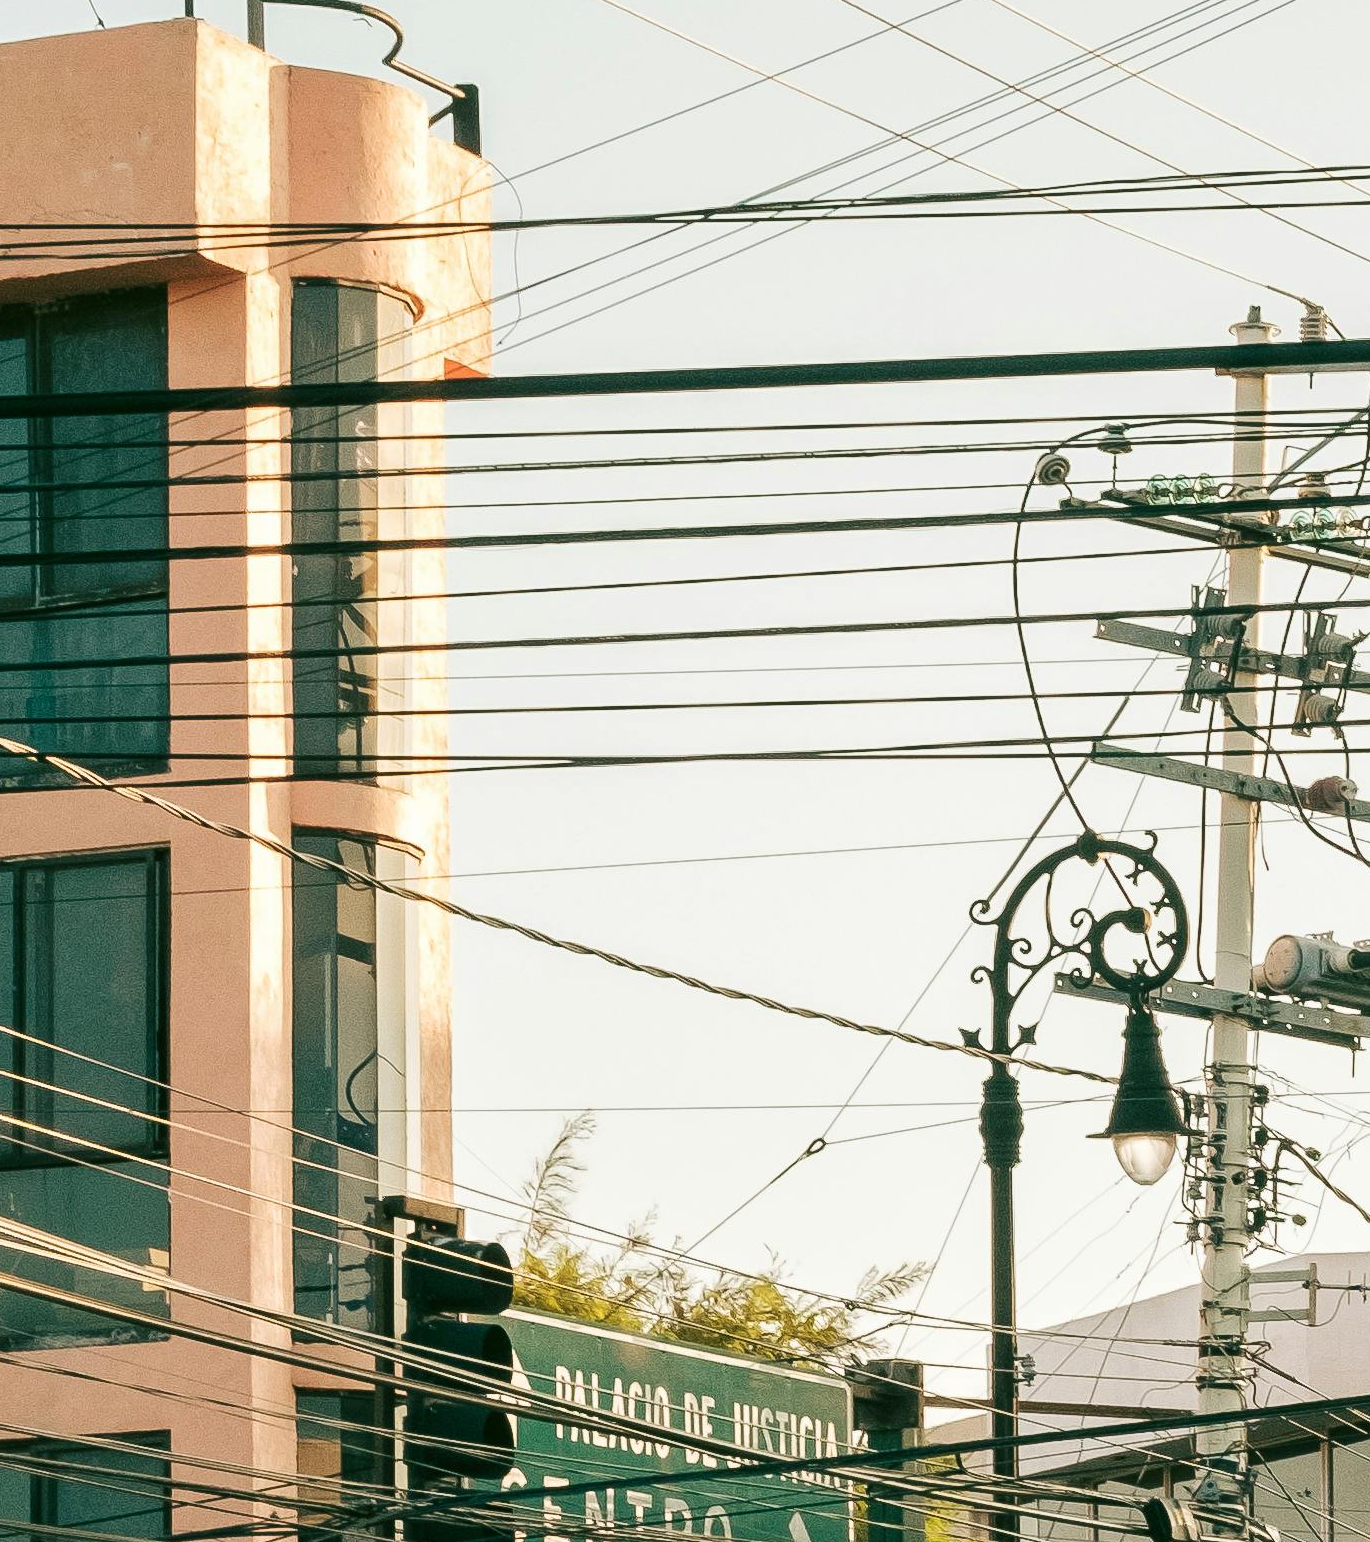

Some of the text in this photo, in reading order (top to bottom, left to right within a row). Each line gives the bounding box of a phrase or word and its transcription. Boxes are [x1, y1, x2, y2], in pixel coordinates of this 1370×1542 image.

[555, 1365, 841, 1489] PALACIO DE JUSTICIA
